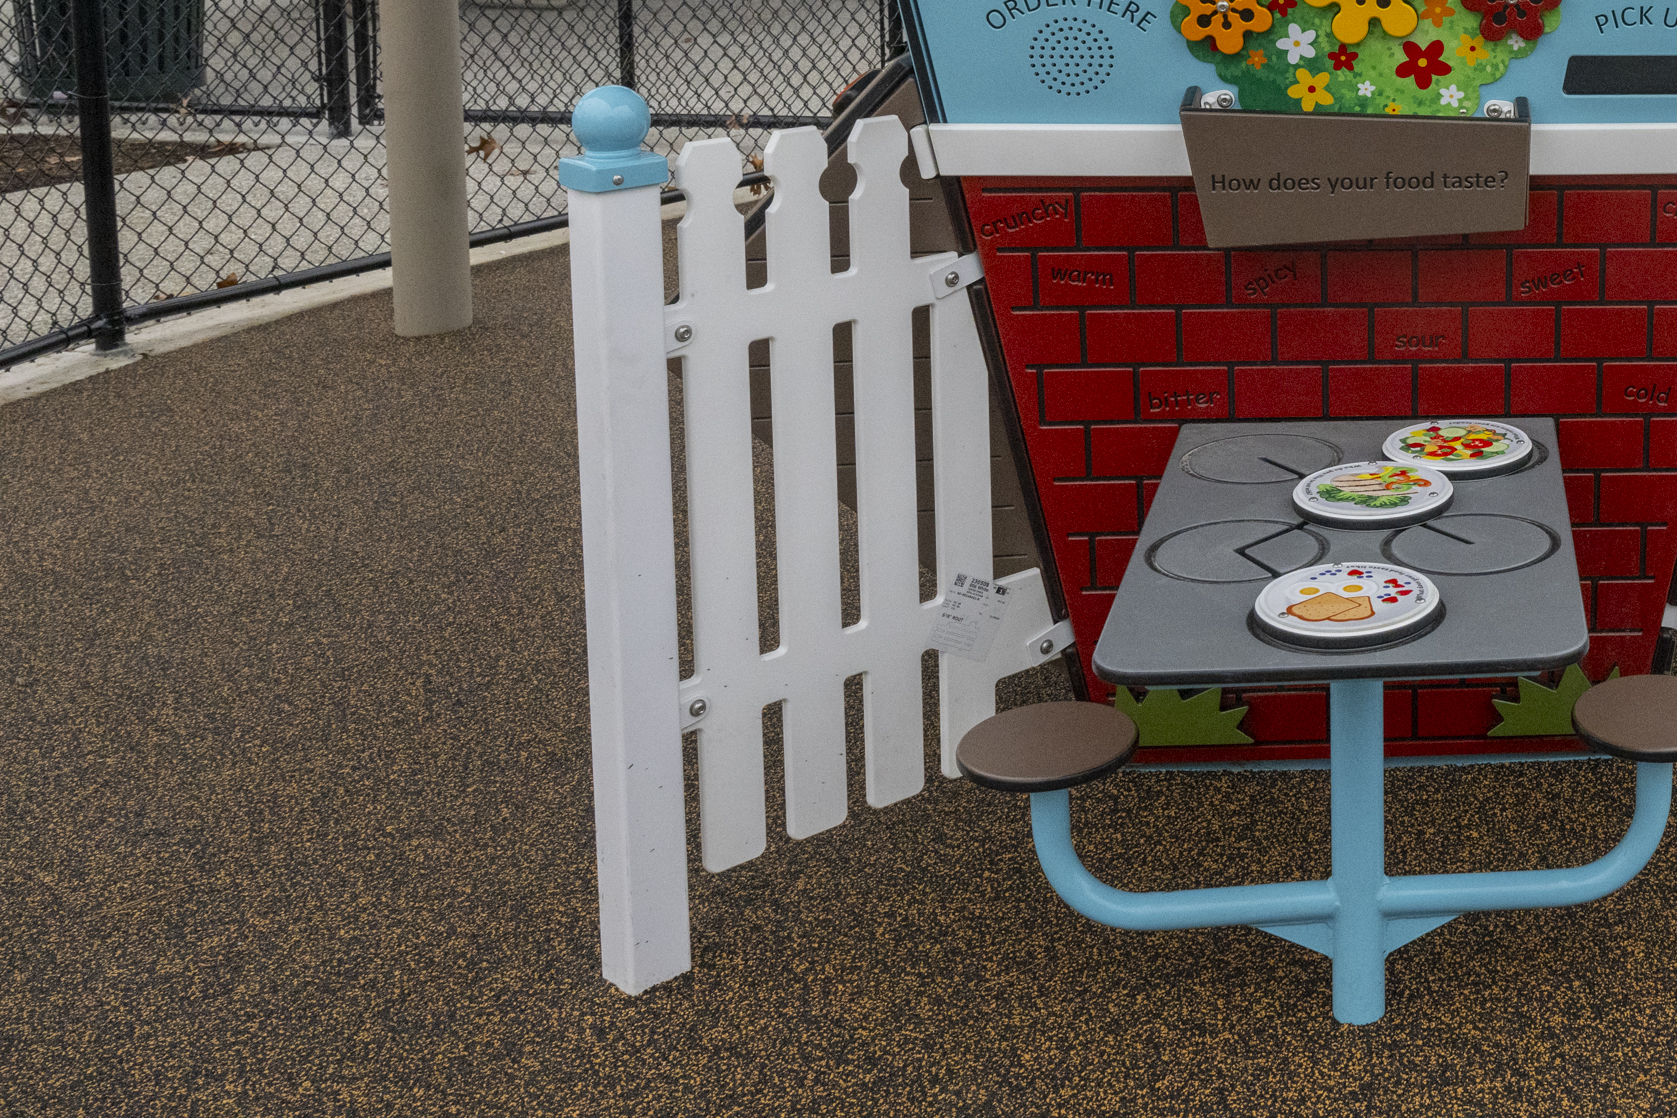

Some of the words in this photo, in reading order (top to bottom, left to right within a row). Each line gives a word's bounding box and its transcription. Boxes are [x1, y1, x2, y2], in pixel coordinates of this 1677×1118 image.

[1594, 5, 1654, 34] PICK
[1210, 173, 1261, 193] How
[1268, 172, 1321, 193] does
[1327, 175, 1379, 196] your
[1384, 170, 1436, 191] food
[1442, 170, 1510, 191] taste?
[980, 197, 1071, 239] crunchy
[1050, 265, 1115, 289] warm
[1243, 259, 1299, 299] spicy
[1519, 262, 1587, 297] sweet
[1394, 332, 1446, 351] sour
[1147, 387, 1222, 413] bitter
[1623, 383, 1673, 407] cold
